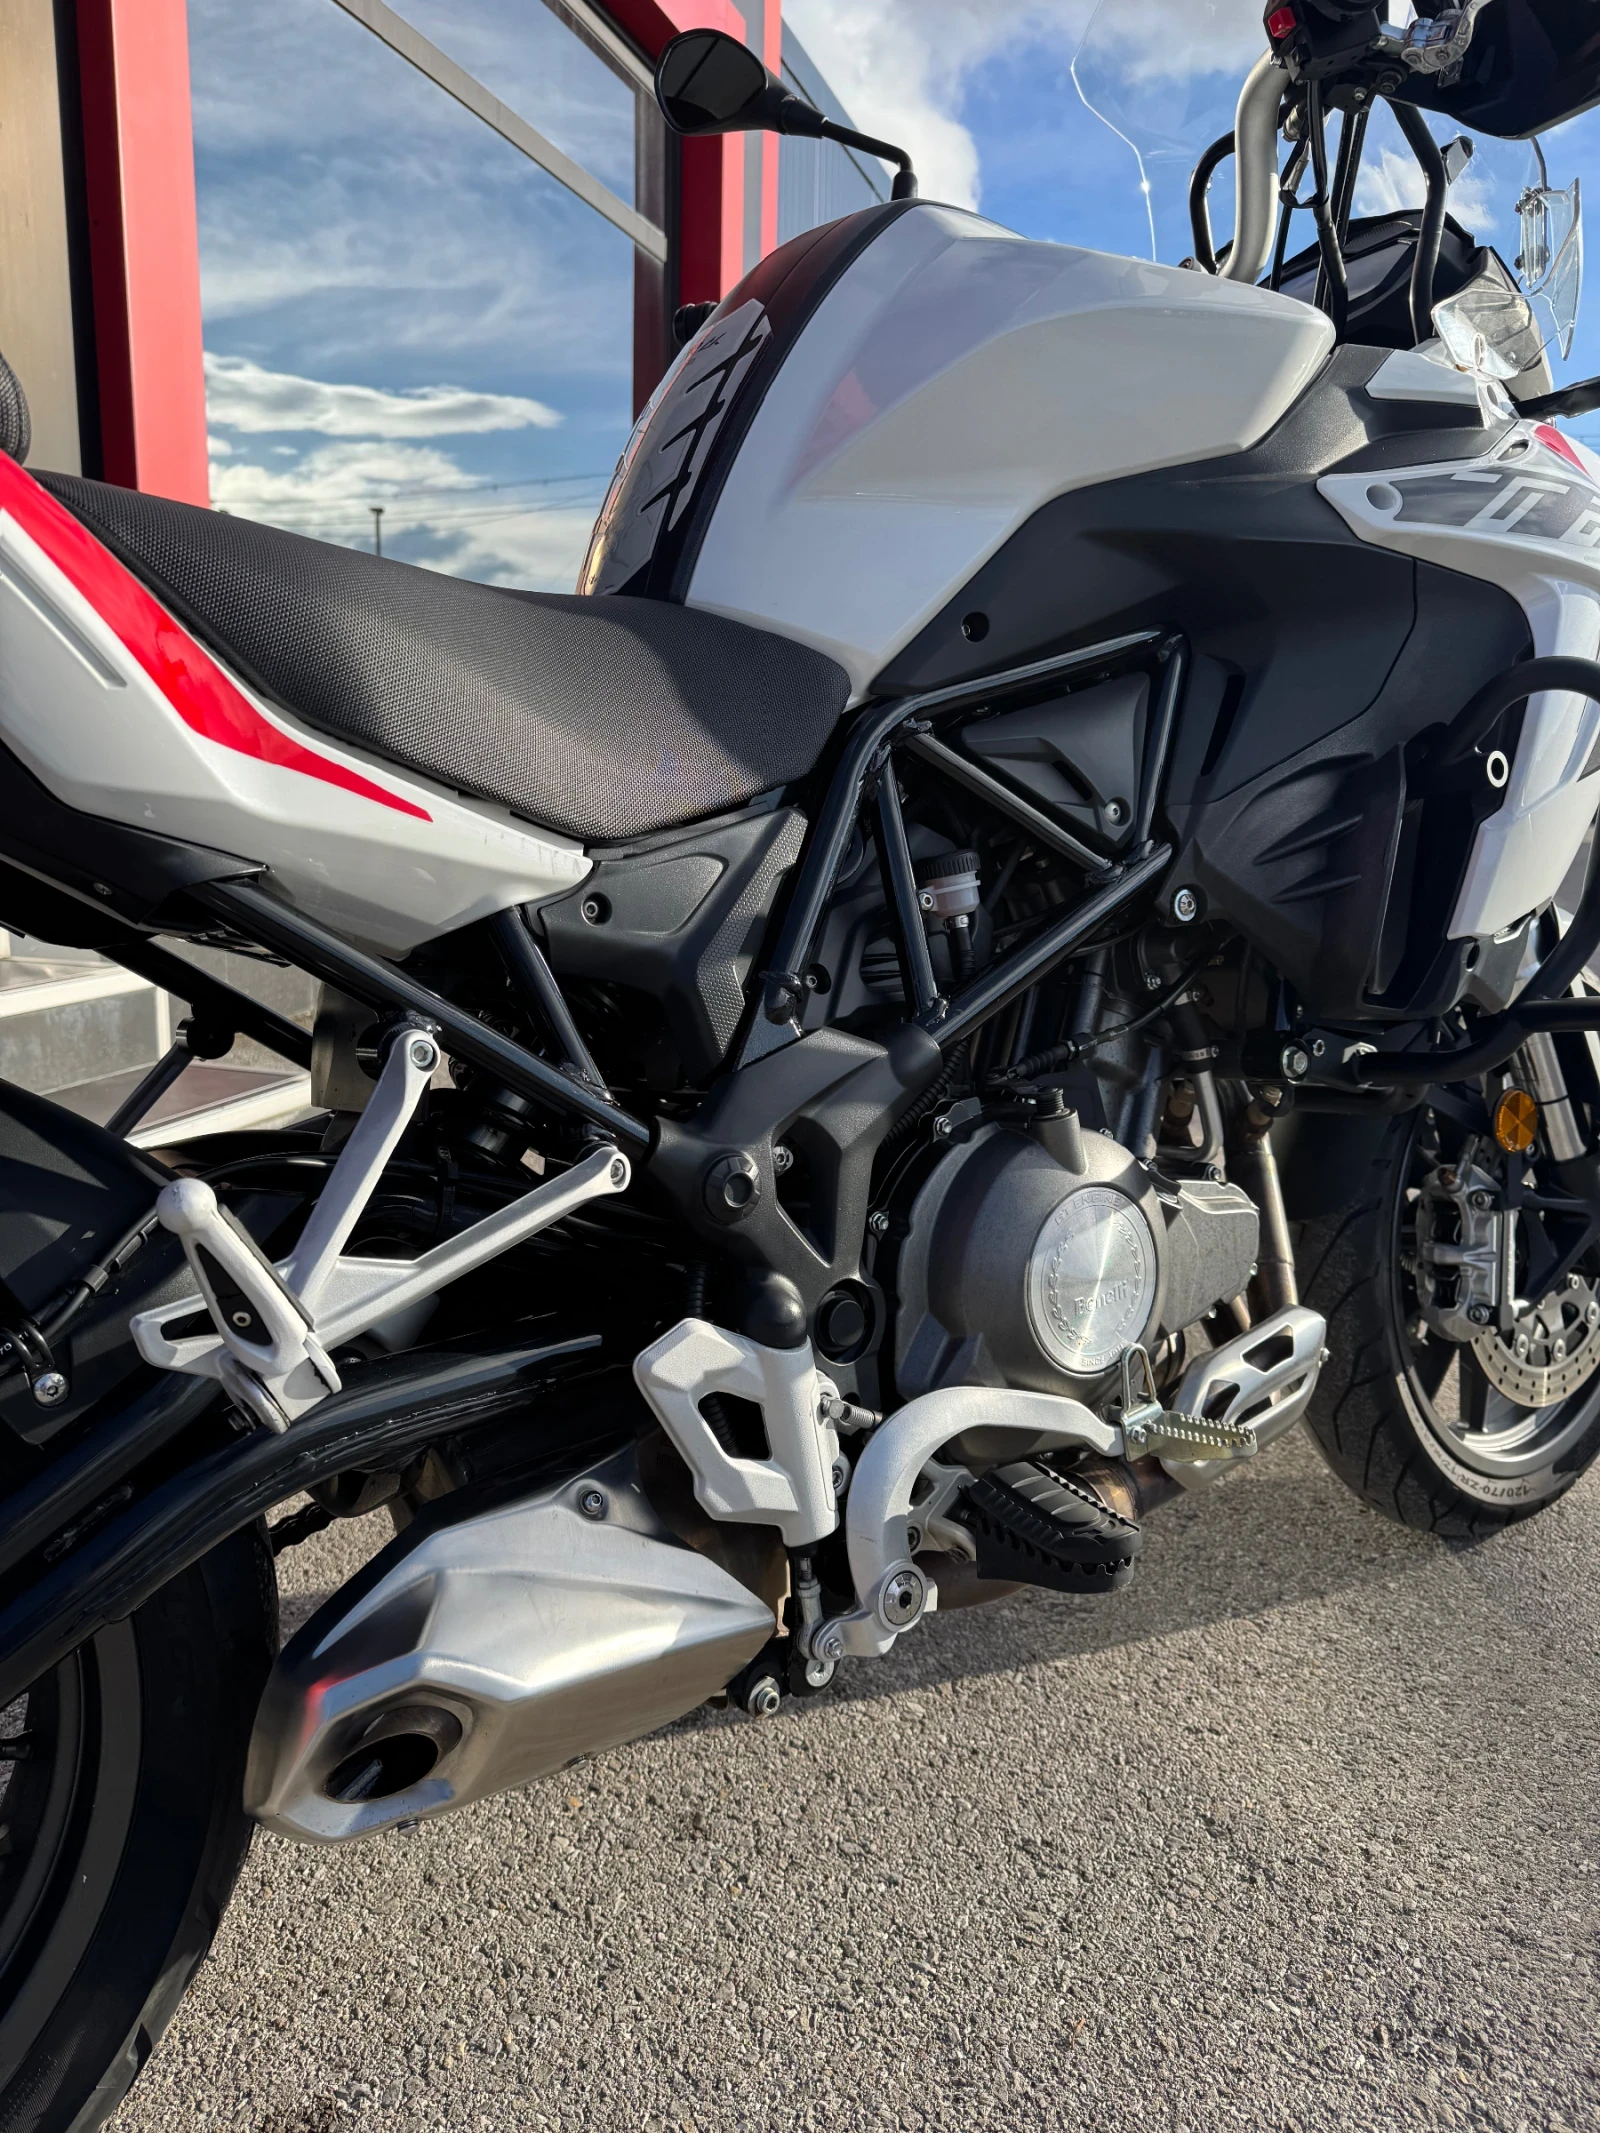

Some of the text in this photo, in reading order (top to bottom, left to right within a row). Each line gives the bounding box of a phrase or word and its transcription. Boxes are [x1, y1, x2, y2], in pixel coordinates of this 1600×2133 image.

[1072, 1193, 1120, 1209] ENGINE
[1074, 1281, 1129, 1316] Benelli
[1460, 1474, 1479, 1490] ZR
[1482, 1484, 1531, 1498] 120/70
